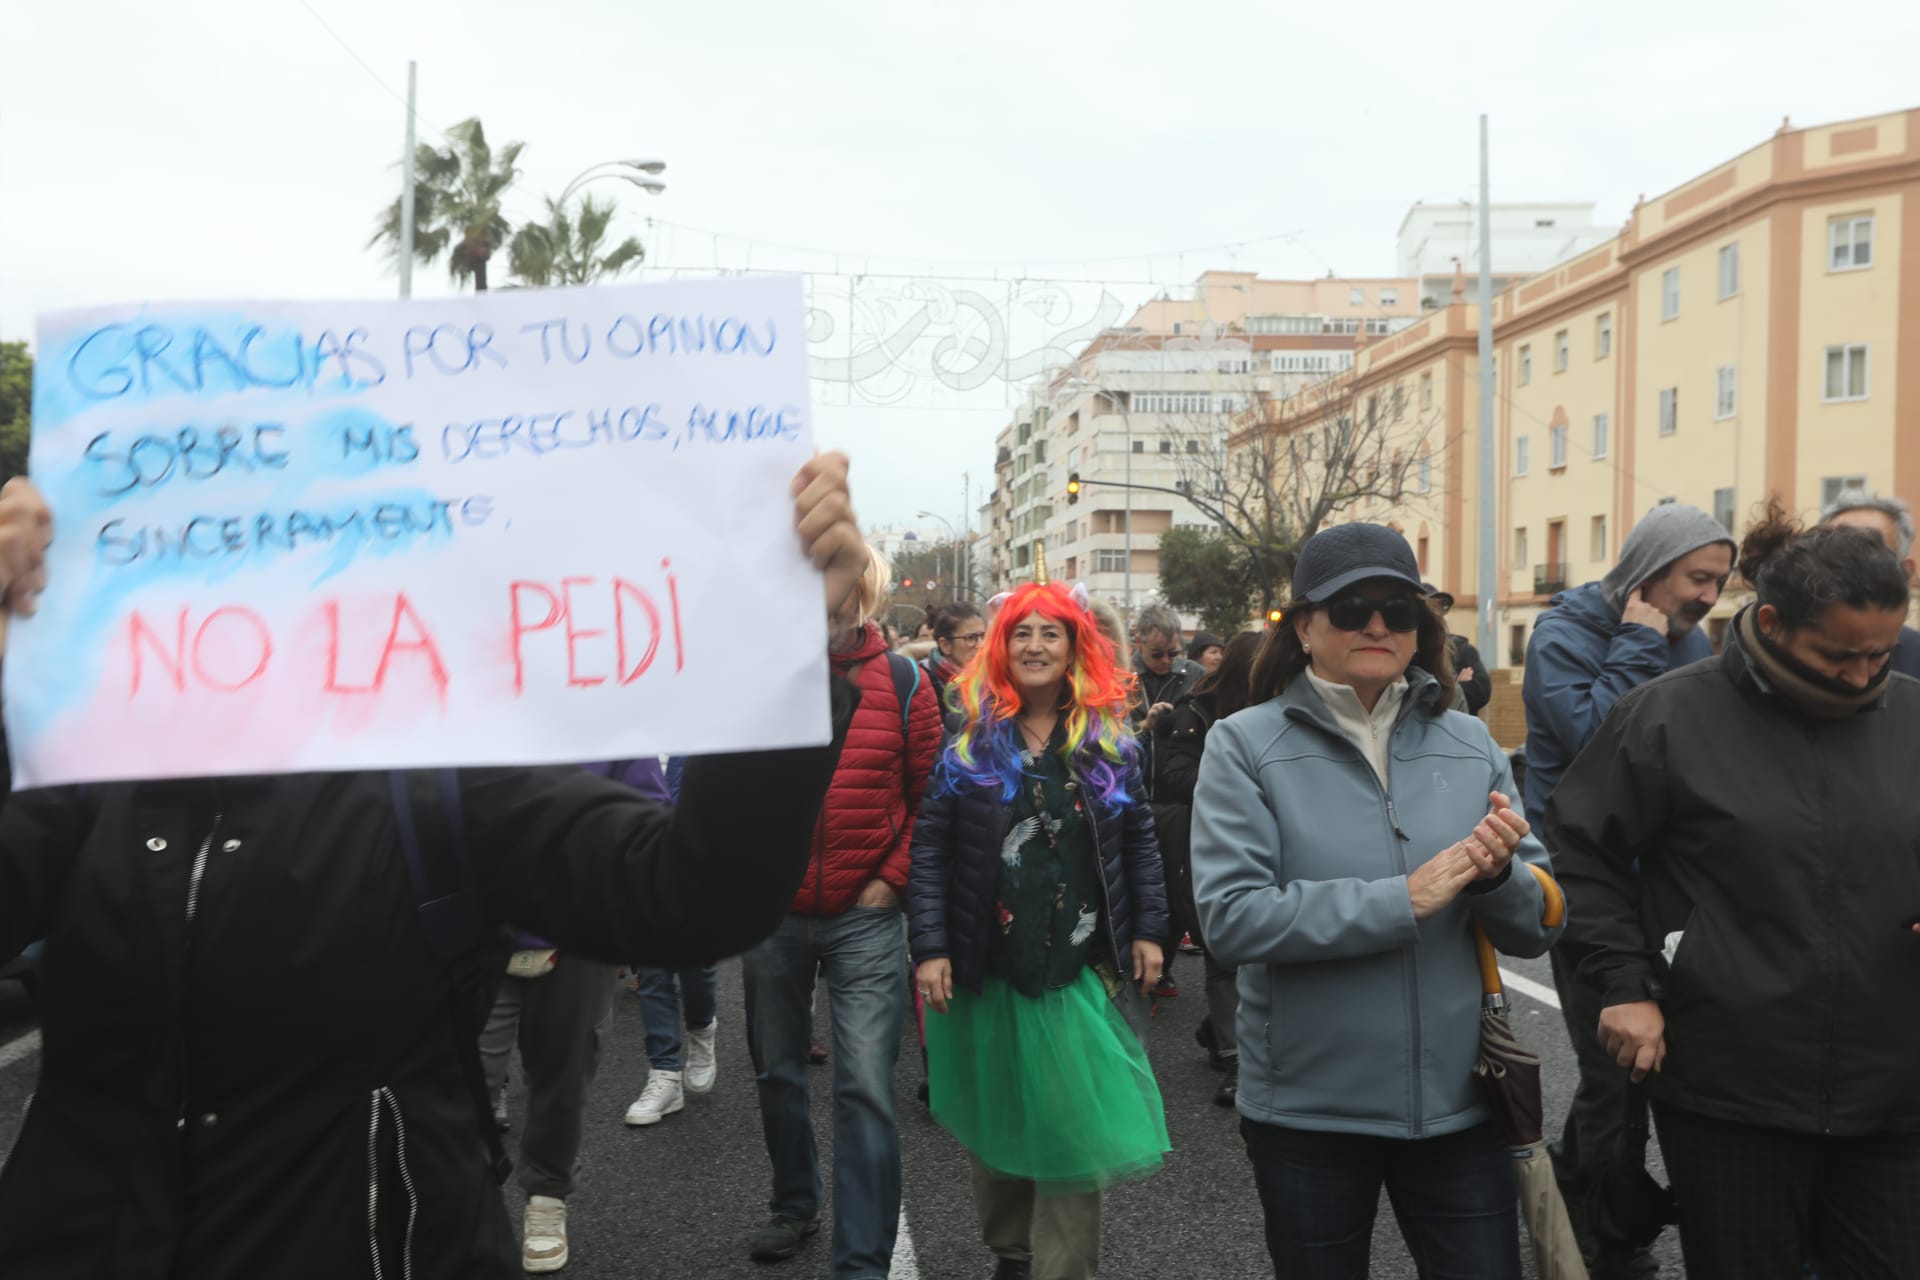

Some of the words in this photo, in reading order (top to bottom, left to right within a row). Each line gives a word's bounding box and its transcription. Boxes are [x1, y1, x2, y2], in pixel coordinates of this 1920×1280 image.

[67, 322, 386, 400] GRACIAS
[403, 321, 508, 380] POR
[520, 316, 591, 365] TU
[84, 423, 289, 497] SOBRE
[342, 420, 421, 464] MIS
[128, 604, 274, 700] NO
[324, 590, 450, 707] LA
